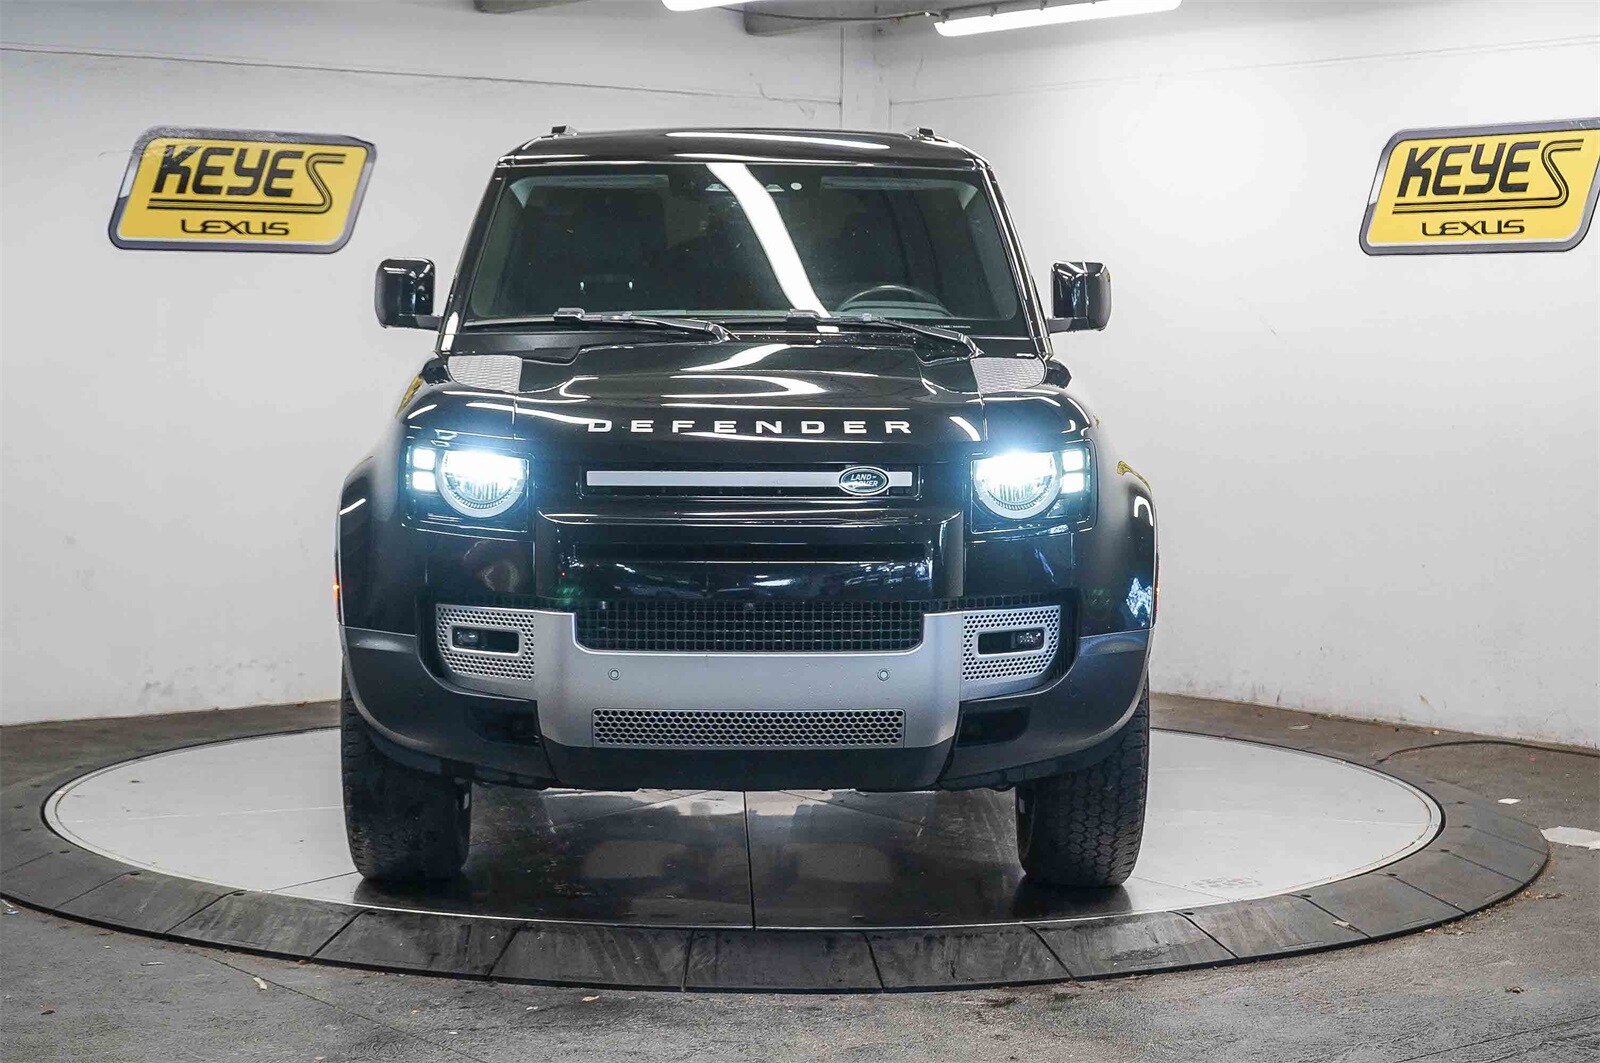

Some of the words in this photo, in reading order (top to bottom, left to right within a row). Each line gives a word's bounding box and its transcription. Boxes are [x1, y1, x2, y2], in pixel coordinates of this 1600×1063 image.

[149, 144, 346, 213] KEYES
[1394, 138, 1584, 213] KEYES
[181, 219, 289, 235] LEXUS
[1421, 219, 1525, 236] LEXUS
[587, 420, 912, 433] DEFENDER
